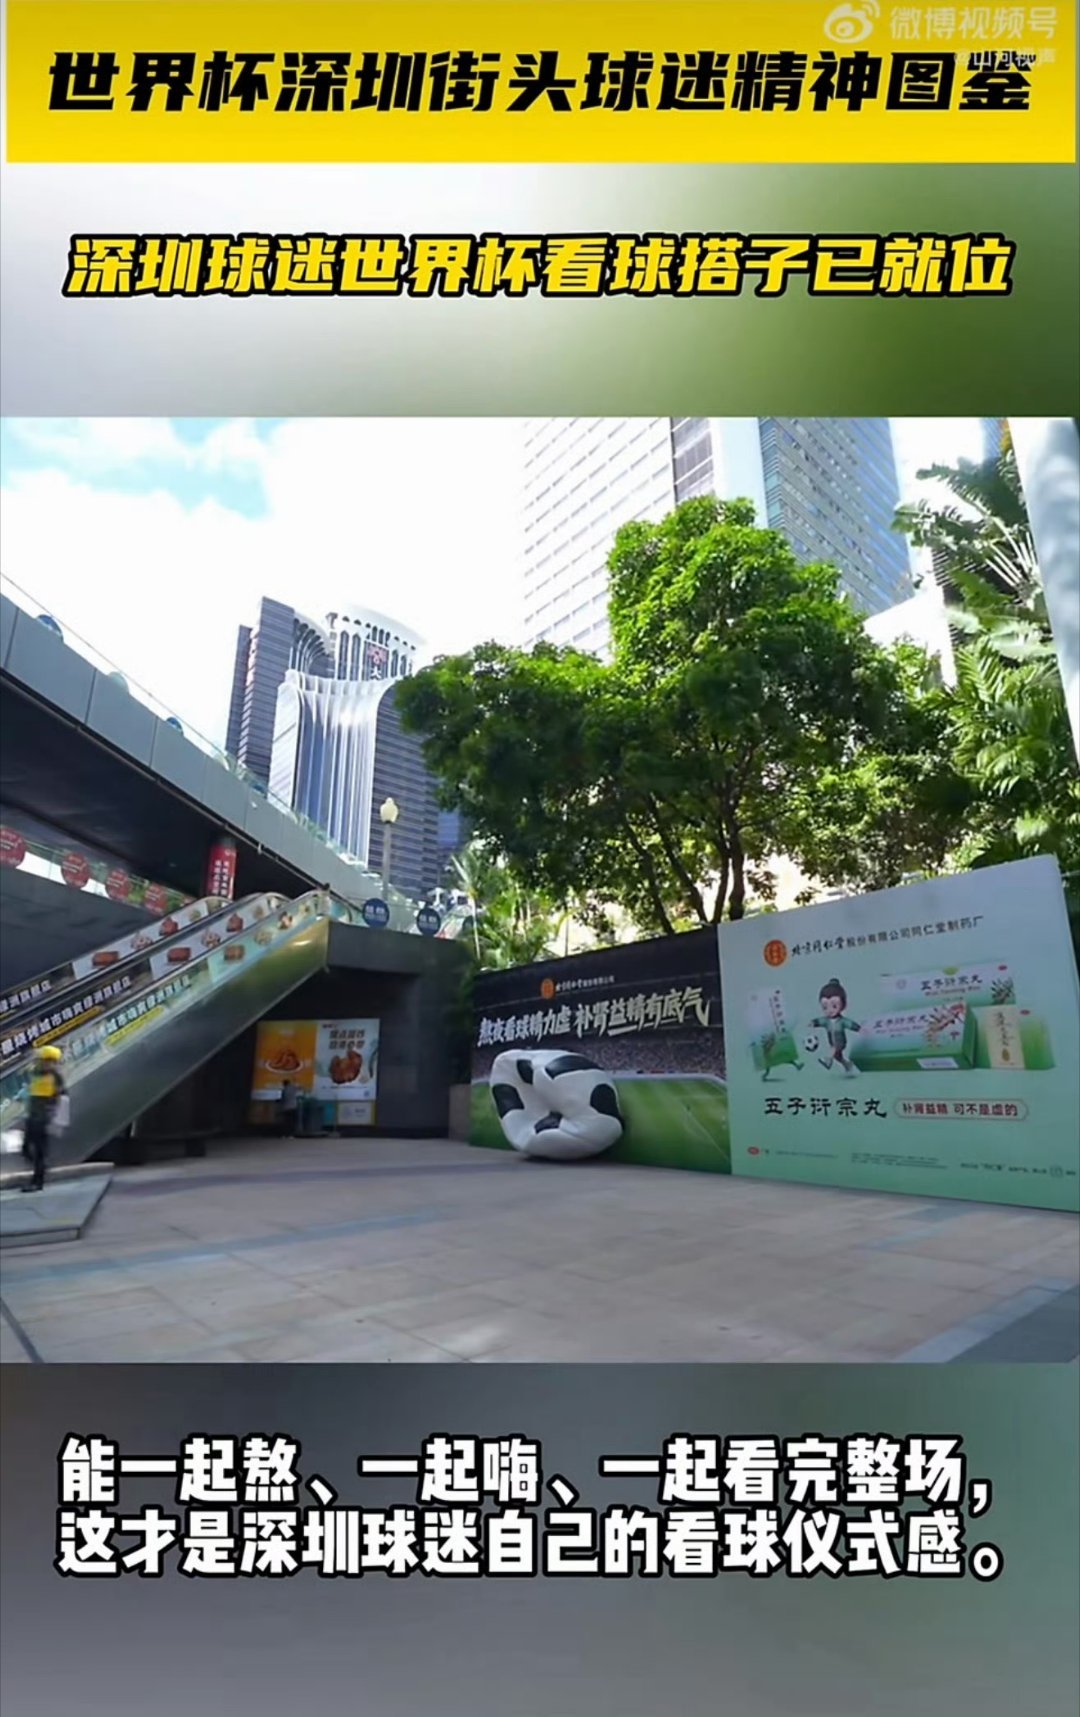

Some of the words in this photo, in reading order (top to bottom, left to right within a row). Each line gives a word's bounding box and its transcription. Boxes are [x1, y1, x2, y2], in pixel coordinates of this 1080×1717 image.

[477, 1005, 572, 1047] 熬夜看球精力虚
[575, 986, 711, 1038] 补肾益精有底气
[764, 1097, 887, 1118] 五子衍宗丸
[902, 1103, 948, 1115] 补肾益精
[953, 1103, 1018, 1116] 可不是虚的
